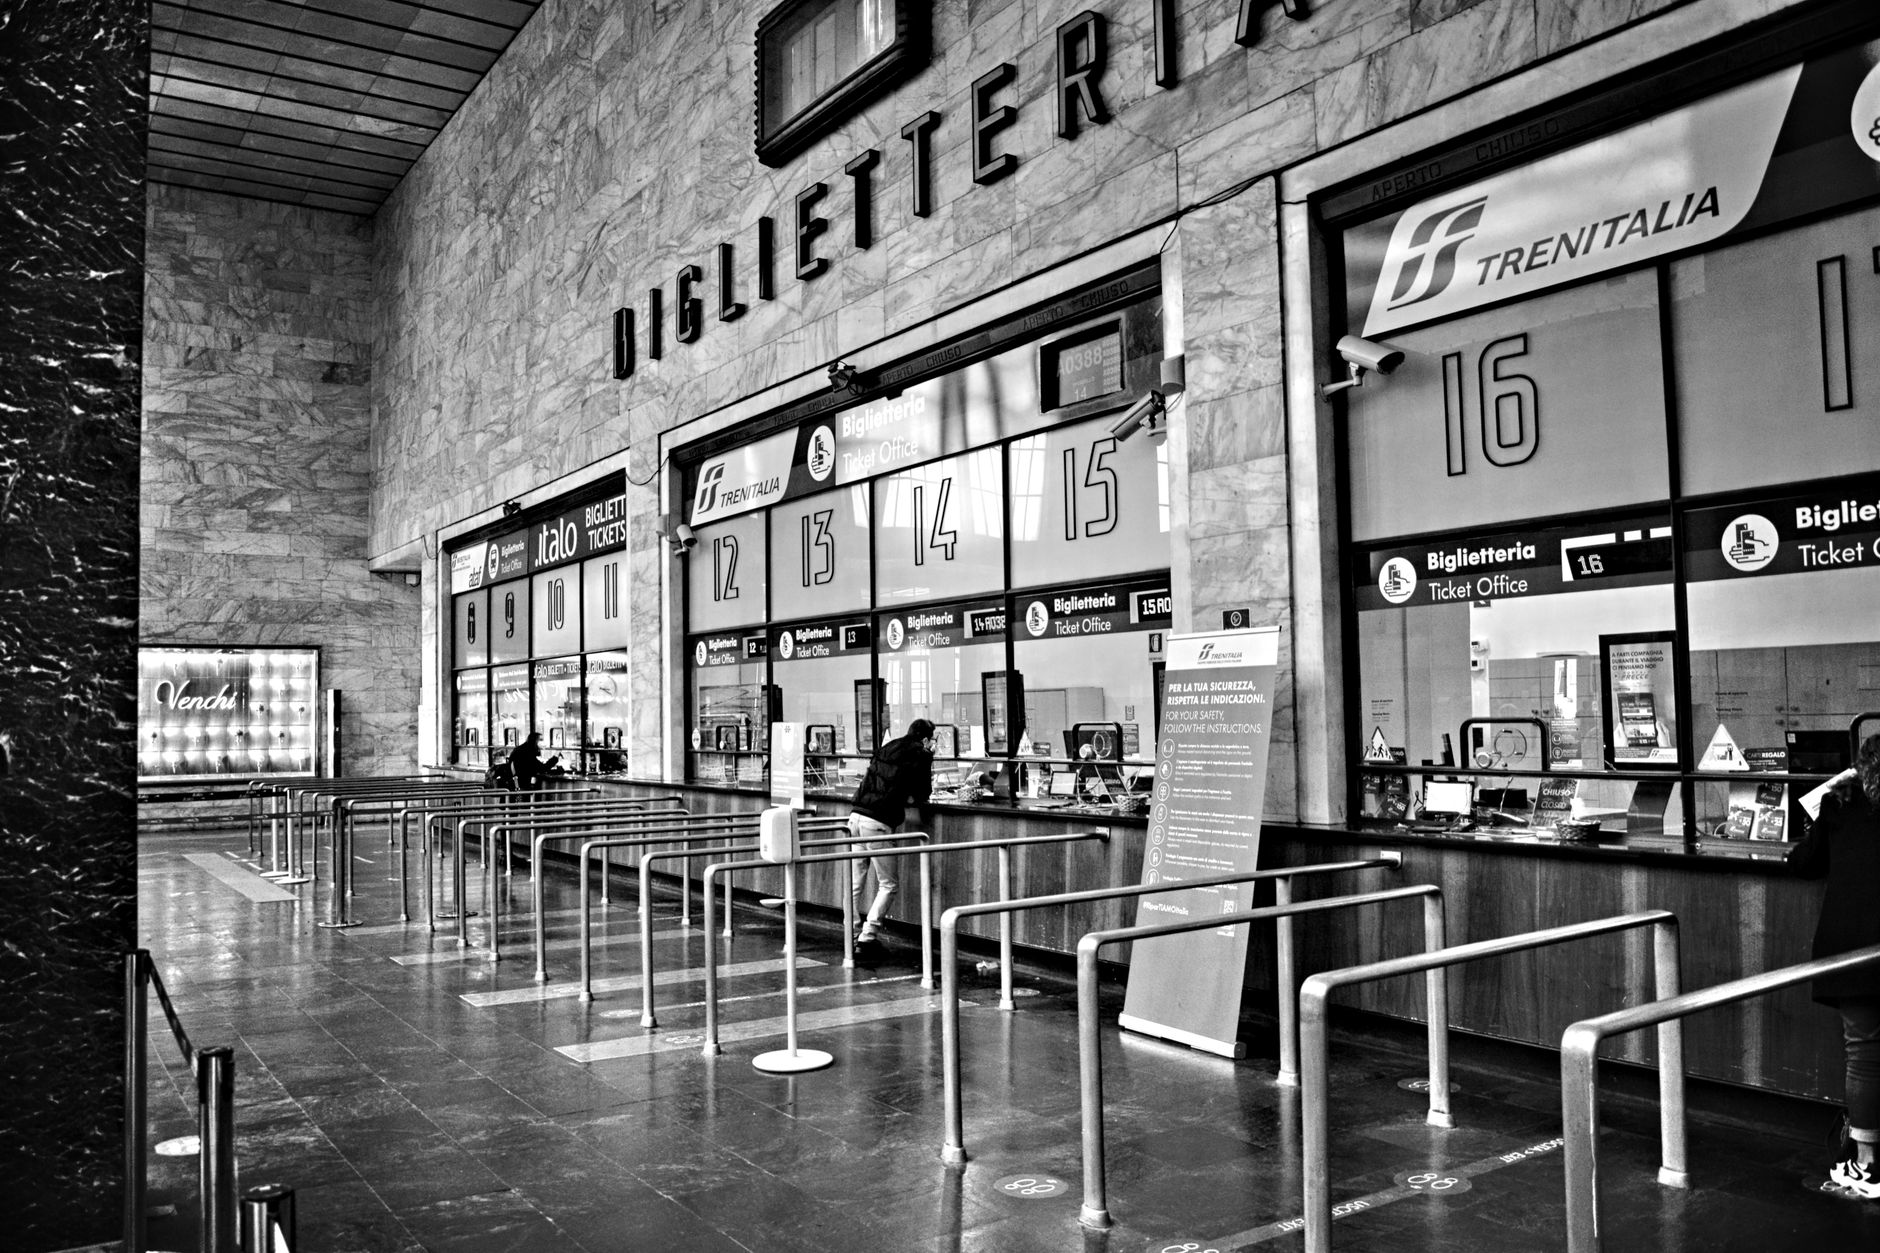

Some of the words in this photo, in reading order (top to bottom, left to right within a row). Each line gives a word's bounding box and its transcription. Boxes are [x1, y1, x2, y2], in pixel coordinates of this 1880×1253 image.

[1372, 162, 1442, 201] APERTO
[1475, 118, 1559, 161] CHIUSO
[1477, 186, 1720, 286] TRENITALIA
[1080, 280, 1129, 308] CHIUSO
[926, 345, 962, 368] CHIUSO
[1056, 345, 1103, 378] A0388
[842, 393, 925, 438] Biglietteria
[1442, 332, 1539, 477] 16
[842, 451, 876, 475] Ticket
[879, 437, 919, 463] Office
[720, 476, 780, 508] TRENITALIA
[1063, 437, 1117, 541] 15
[913, 477, 957, 566] 14
[587, 520, 626, 551] TICKETS
[801, 509, 835, 588] 13
[1427, 541, 1536, 572] Biglietteria
[1798, 541, 1864, 566] Ticket
[713, 535, 739, 602] 12
[1577, 553, 1605, 575] 16
[604, 562, 618, 619] 11
[1428, 580, 1471, 601] Ticket
[1477, 575, 1528, 597] Office
[505, 591, 515, 639] 9
[547, 578, 565, 630] 10
[1054, 593, 1116, 614] Biglietteria
[1142, 598, 1156, 616] 15
[467, 601, 476, 644] 8
[907, 611, 953, 630] Biglietteria
[1055, 620, 1080, 636] Ticket
[1081, 617, 1112, 633] Office
[708, 637, 737, 651] Biglietteria
[796, 626, 833, 643] Biglietteria
[847, 631, 857, 643] 13
[908, 634, 927, 649] Ticket
[928, 633, 950, 646] Office
[749, 642, 757, 654] 12
[796, 646, 811, 658] Ticket
[812, 645, 830, 657] Office
[1211, 652, 1243, 660] TRENITALIA
[155, 680, 238, 710] Venchi
[1168, 683, 1182, 693] PER
[1183, 682, 1193, 692] LA
[1193, 682, 1208, 692] TUA
[1210, 680, 1256, 692] SICUREZZA,
[1167, 695, 1199, 706] RISPETTA
[1200, 695, 1209, 705] LE
[1210, 693, 1266, 705] INDICAZIONI.
[1165, 711, 1179, 721] FOR
[1179, 710, 1198, 720] YOUR
[1199, 709, 1225, 721] SAFETY,
[1163, 723, 1192, 734] FOLLOW
[1192, 723, 1206, 734] THE
[1206, 722, 1263, 734] INSTRUCTIONS.
[1761, 751, 1786, 759] REGALO
[1542, 788, 1572, 797] CHIUSO
